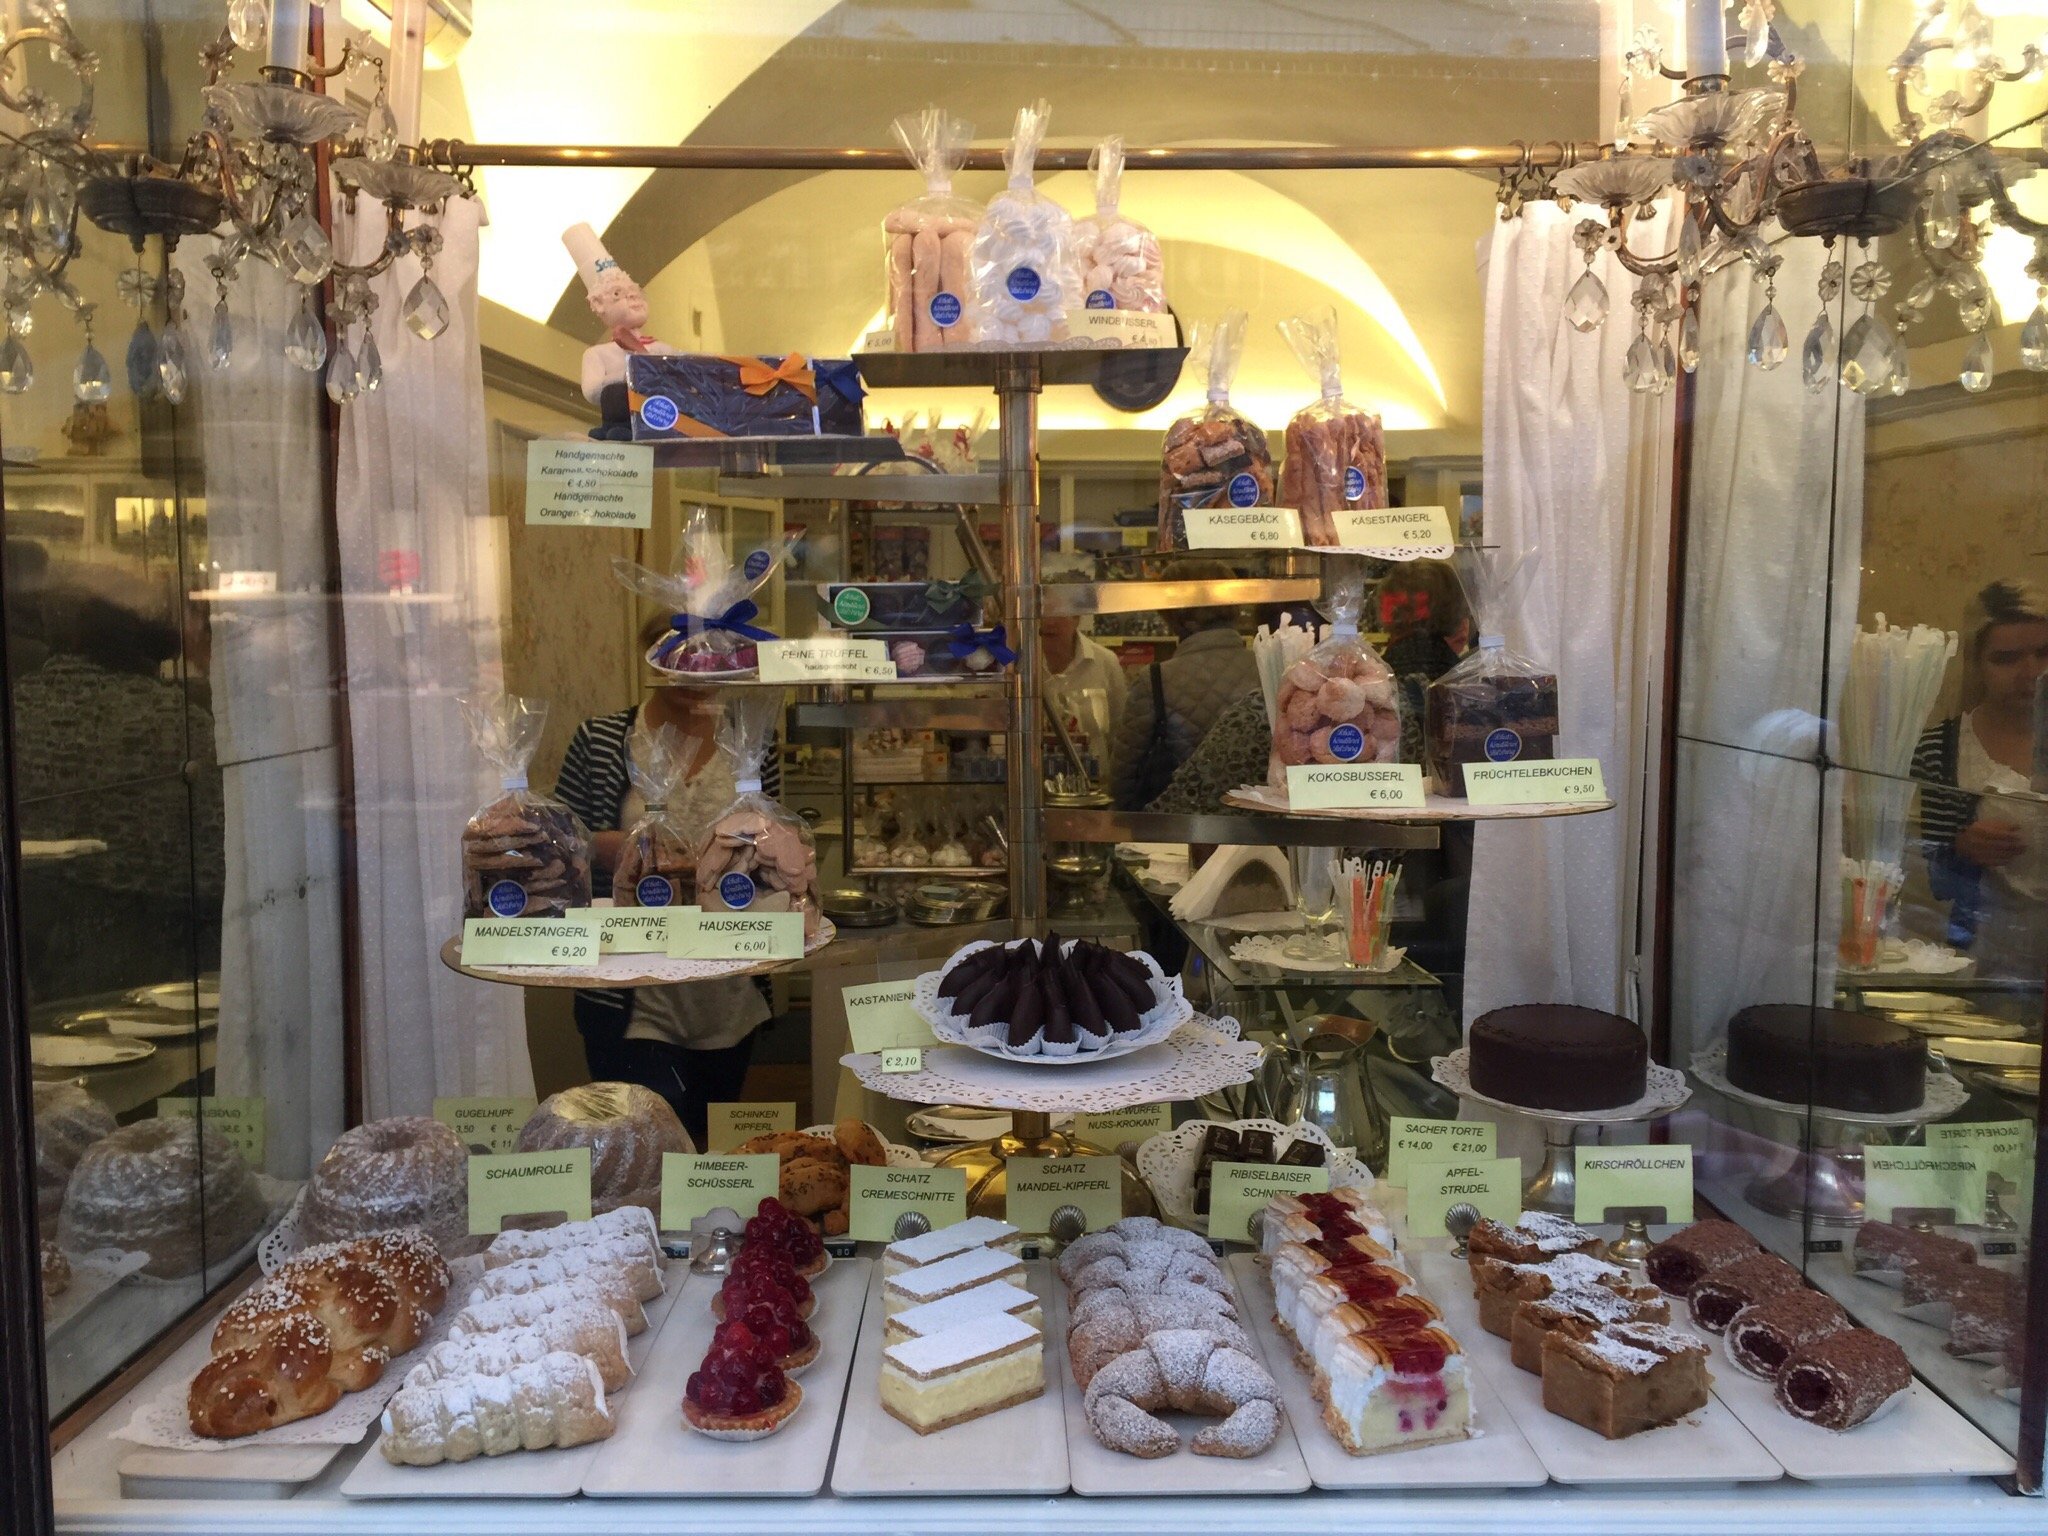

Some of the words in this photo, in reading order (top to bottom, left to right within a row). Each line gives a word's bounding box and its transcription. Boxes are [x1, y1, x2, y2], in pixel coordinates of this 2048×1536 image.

[555, 449, 625, 461] Handgemachte
[567, 479, 574, 487] €
[576, 479, 597, 489] 4,80
[553, 492, 624, 502] Handgemachte
[540, 508, 637, 519] Orangenhokolade
[1209, 512, 1280, 524] KÄSEGEBÄCK
[1251, 531, 1258, 540] €
[1260, 531, 1279, 541] 6,80
[1403, 531, 1410, 539] €
[1412, 530, 1432, 540] 5,20
[782, 649, 815, 659] FEINE
[865, 666, 871, 675] €
[873, 666, 893, 676] 6,50
[1308, 772, 1404, 783] KOKOSBUSSERL
[1473, 766, 1593, 780] FRÜCHTELEBKUCHEN
[1370, 789, 1377, 799] €
[1380, 789, 1403, 800] 6,00
[1564, 785, 1571, 794] €
[1573, 784, 1595, 794] 9,50
[601, 916, 668, 929] ORENTINE
[698, 921, 773, 931] HAUSKEKSE
[475, 926, 589, 938] MANDELSTANGERL
[645, 930, 654, 941] €
[551, 946, 560, 956] €
[562, 946, 587, 957] 9,20
[734, 942, 742, 951] €
[744, 941, 766, 952] 6,00
[885, 1056, 893, 1067] €
[895, 1056, 917, 1068] 2,10
[455, 1108, 514, 1118] GUGELHUPF
[730, 1110, 779, 1119] SCHINKEN
[491, 1124, 497, 1133] €
[734, 1122, 774, 1131] KIPFERL
[1088, 1118, 1161, 1129] NUSS-KROKANT
[1405, 1124, 1448, 1135] SACHER
[1451, 1126, 1485, 1137] TORTE
[491, 1140, 497, 1148] €
[1398, 1140, 1405, 1149] €
[1407, 1141, 1433, 1150] 14,00
[1452, 1143, 1460, 1152] €
[1461, 1143, 1487, 1154] 21,00
[694, 1161, 749, 1171] HIMBEER-
[1042, 1163, 1086, 1175] SCHATZ
[1584, 1158, 1685, 1170] KIRSCHRÖLLCHEN
[486, 1163, 574, 1180] SCHAUMROLLE
[1230, 1169, 1312, 1183] RIBISELBAISER
[1446, 1167, 1484, 1178] APFEL-
[687, 1177, 755, 1188] SCHÜSSERL
[886, 1173, 931, 1184] SCHATZ
[1016, 1180, 1111, 1192] MANDEL-KIPFERL
[1440, 1183, 1490, 1195] STRUDEL
[861, 1189, 956, 1202] CREMESCHNITTE
